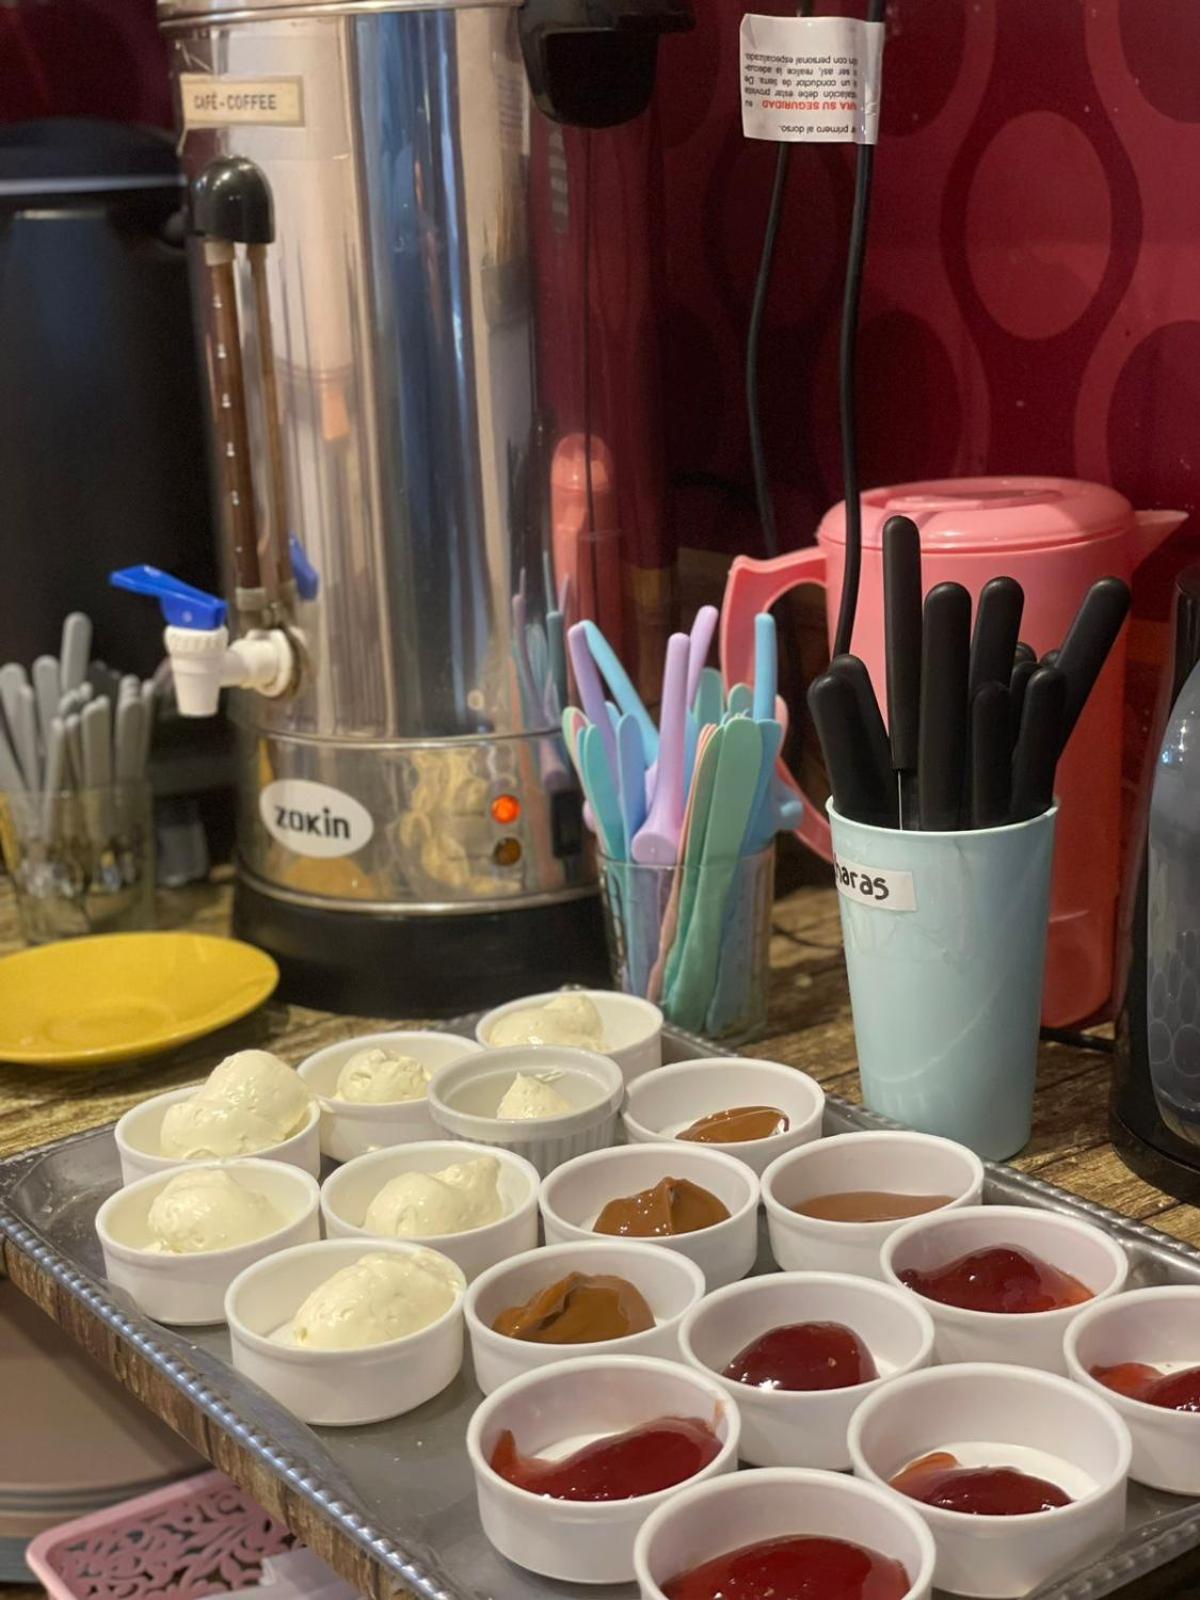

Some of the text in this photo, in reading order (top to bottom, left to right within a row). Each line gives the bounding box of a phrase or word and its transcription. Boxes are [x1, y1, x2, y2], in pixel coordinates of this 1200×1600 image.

[796, 56, 831, 65] personal
[775, 67, 783, 76] la
[787, 68, 814, 76] realice
[838, 68, 850, 76] ser
[782, 79, 792, 87] de
[796, 79, 837, 88] conductor
[840, 79, 851, 87] un
[761, 101, 820, 110] SEGURIDAD
[822, 101, 837, 110] SU
[806, 125, 814, 134] al
[816, 124, 849, 133] primero
